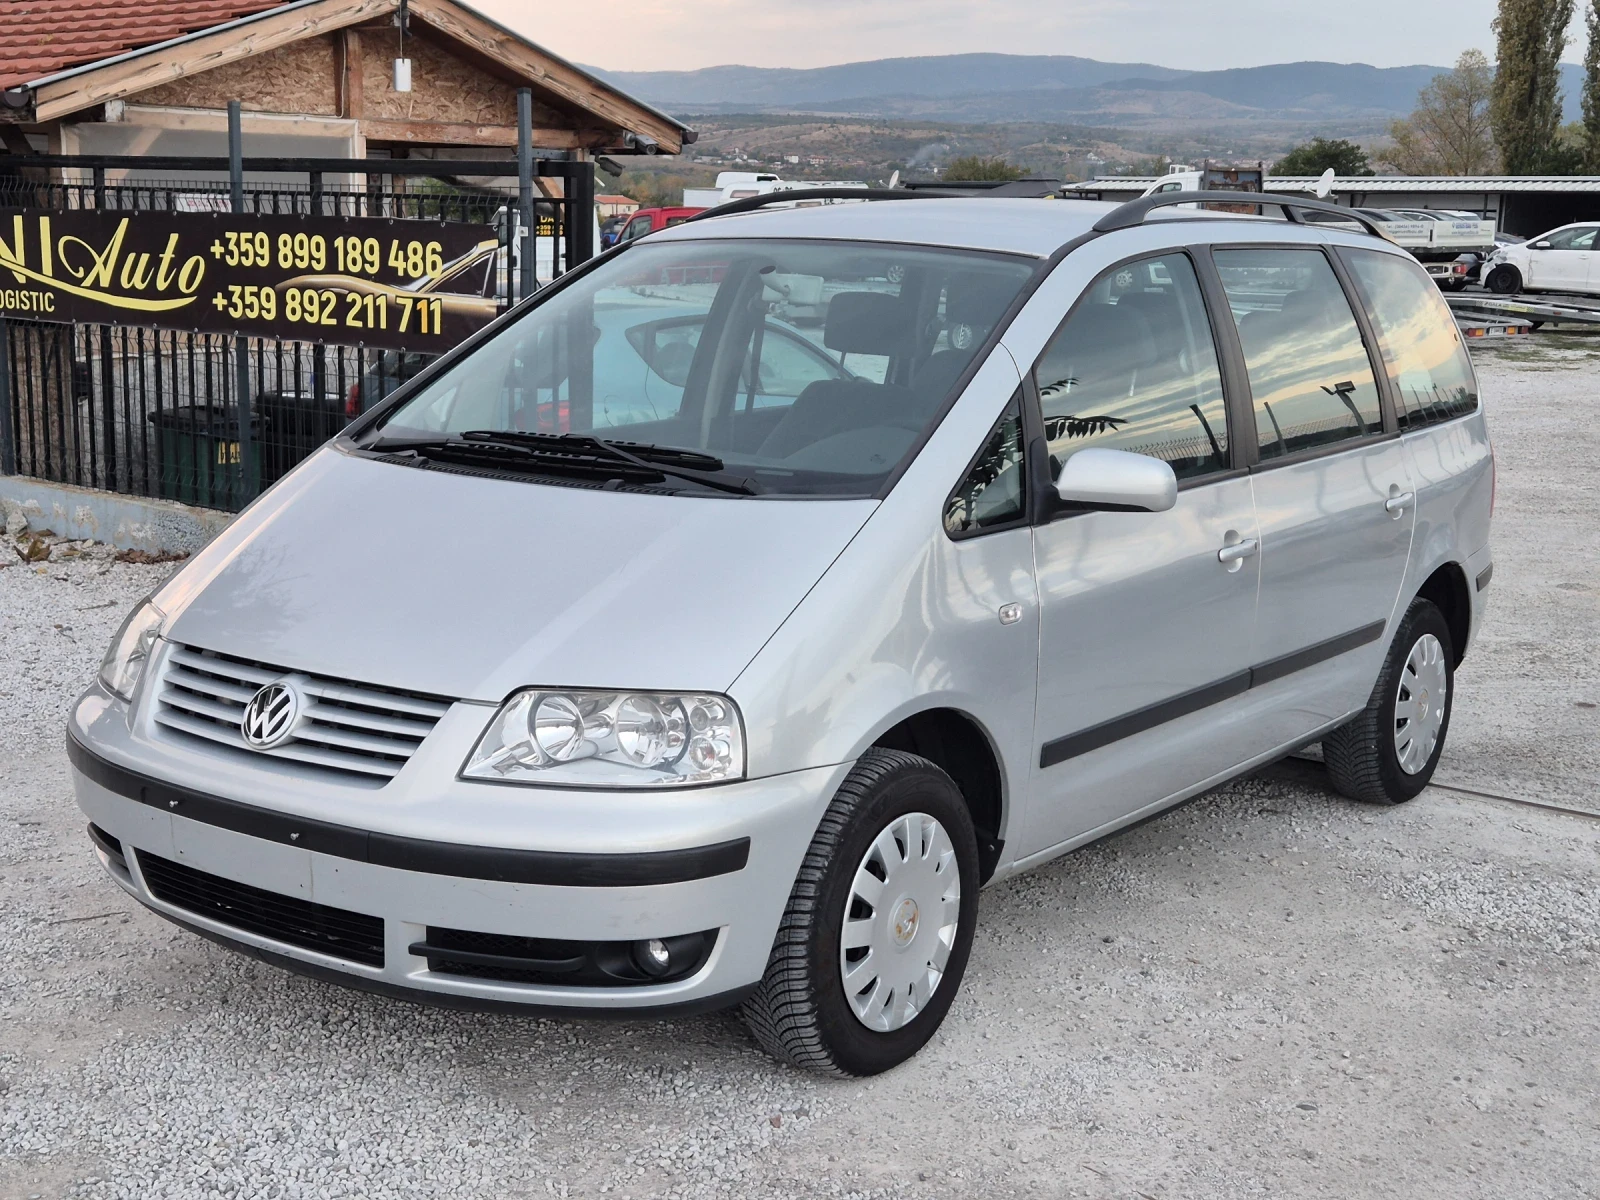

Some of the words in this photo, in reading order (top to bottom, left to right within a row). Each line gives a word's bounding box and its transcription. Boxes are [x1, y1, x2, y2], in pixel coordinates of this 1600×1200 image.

[58, 217, 206, 294] Auto
[210, 231, 270, 267] +359
[278, 233, 326, 271] 899
[334, 236, 380, 274] 189
[388, 239, 443, 278] 486
[212, 285, 276, 321] +359
[285, 288, 337, 325] 892
[346, 292, 387, 329] 211
[396, 297, 442, 335] 711
